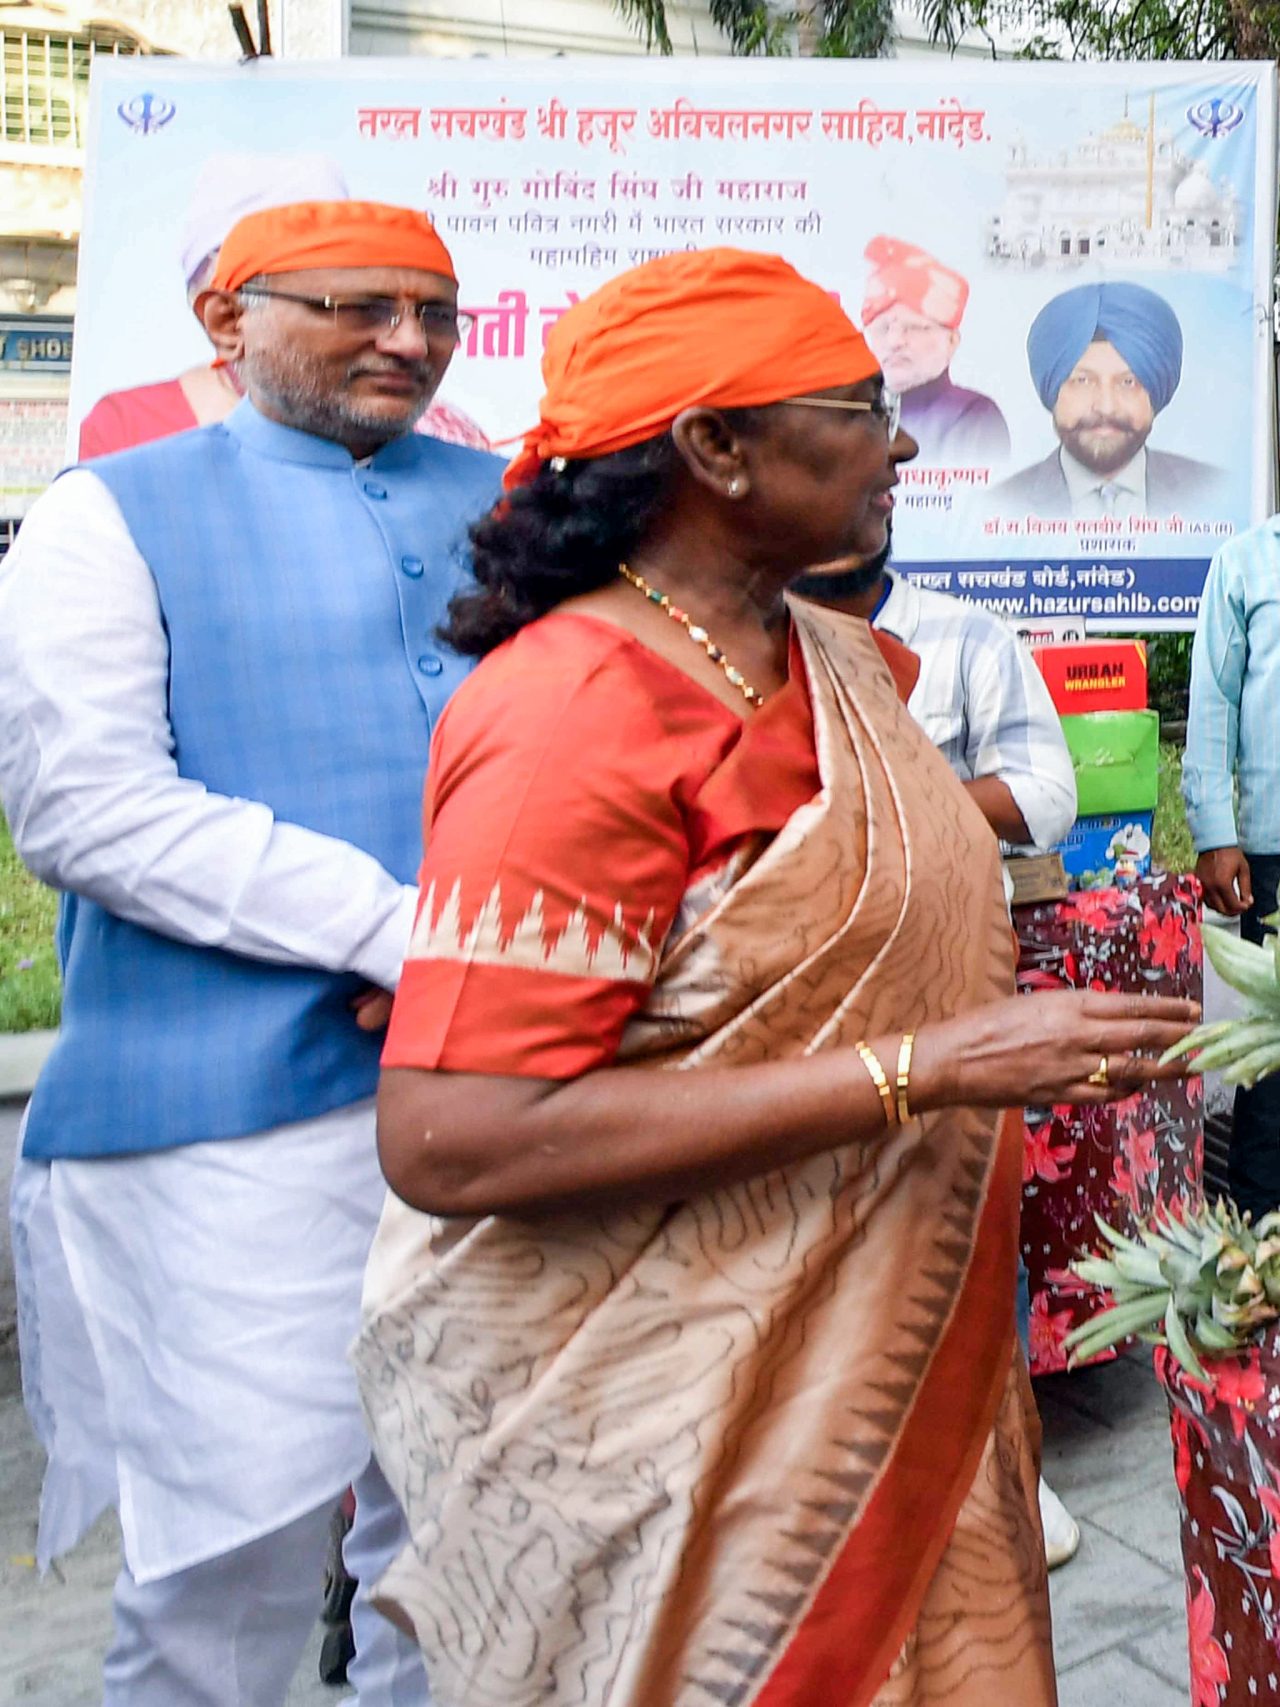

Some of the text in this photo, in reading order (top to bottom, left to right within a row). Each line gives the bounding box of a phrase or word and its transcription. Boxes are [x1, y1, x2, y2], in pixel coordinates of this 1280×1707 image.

[357, 106, 421, 138] तख्त
[429, 98, 527, 139] सचखंड
[536, 98, 568, 138] श्री
[576, 107, 637, 153] हजूर
[427, 171, 457, 199] श्री
[471, 178, 509, 206] गुरु
[670, 172, 702, 199] जी
[715, 178, 808, 200] महाराज
[1066, 662, 1124, 679] URBAN
[1064, 676, 1126, 692] WRANGLER
